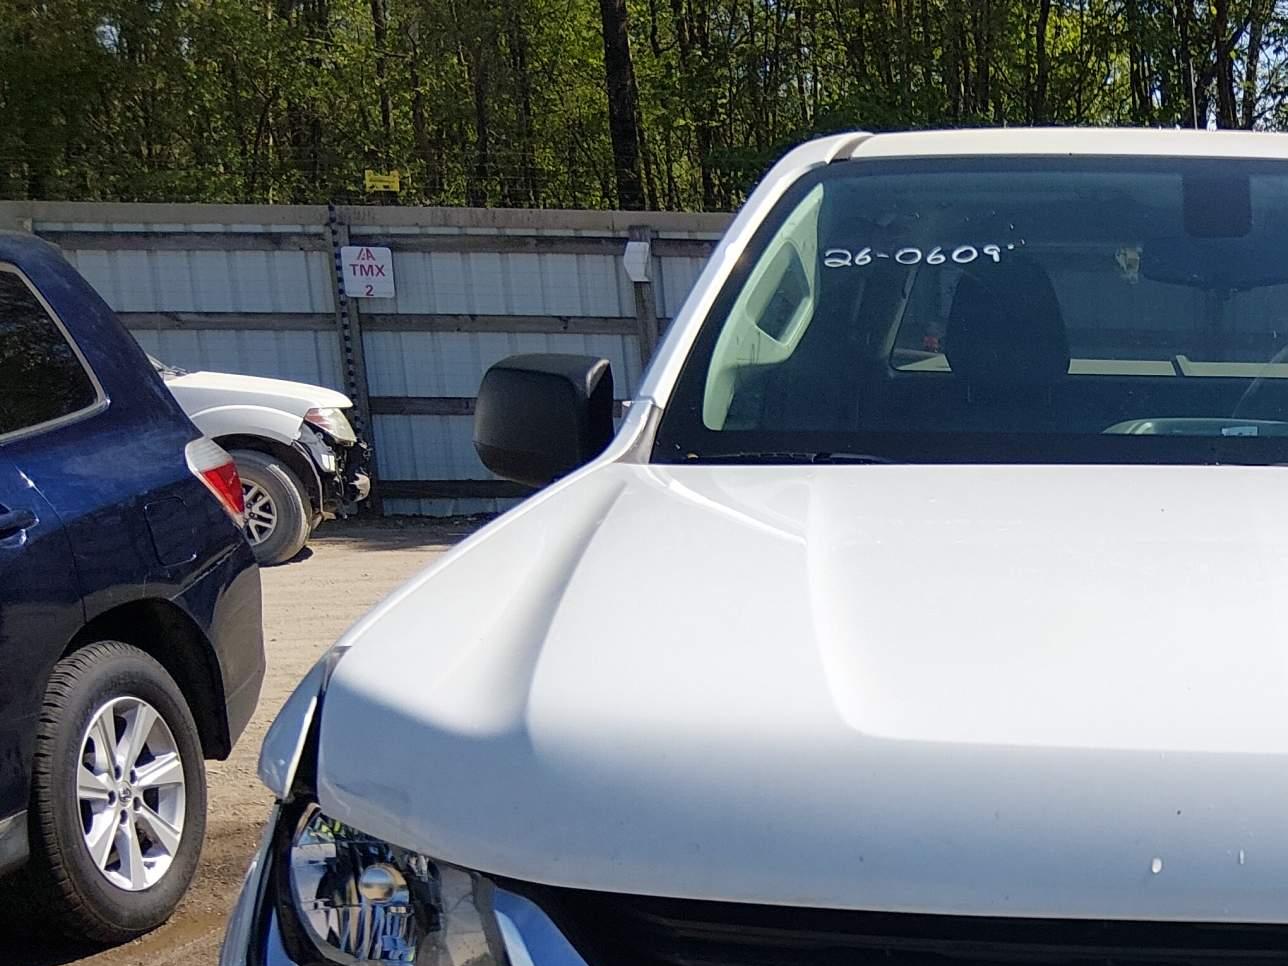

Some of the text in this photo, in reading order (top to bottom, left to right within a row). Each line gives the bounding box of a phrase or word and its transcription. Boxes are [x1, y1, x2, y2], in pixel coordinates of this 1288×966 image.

[823, 244, 1001, 268] 26-0609
[350, 264, 385, 276] TMX
[365, 285, 374, 296] 2
